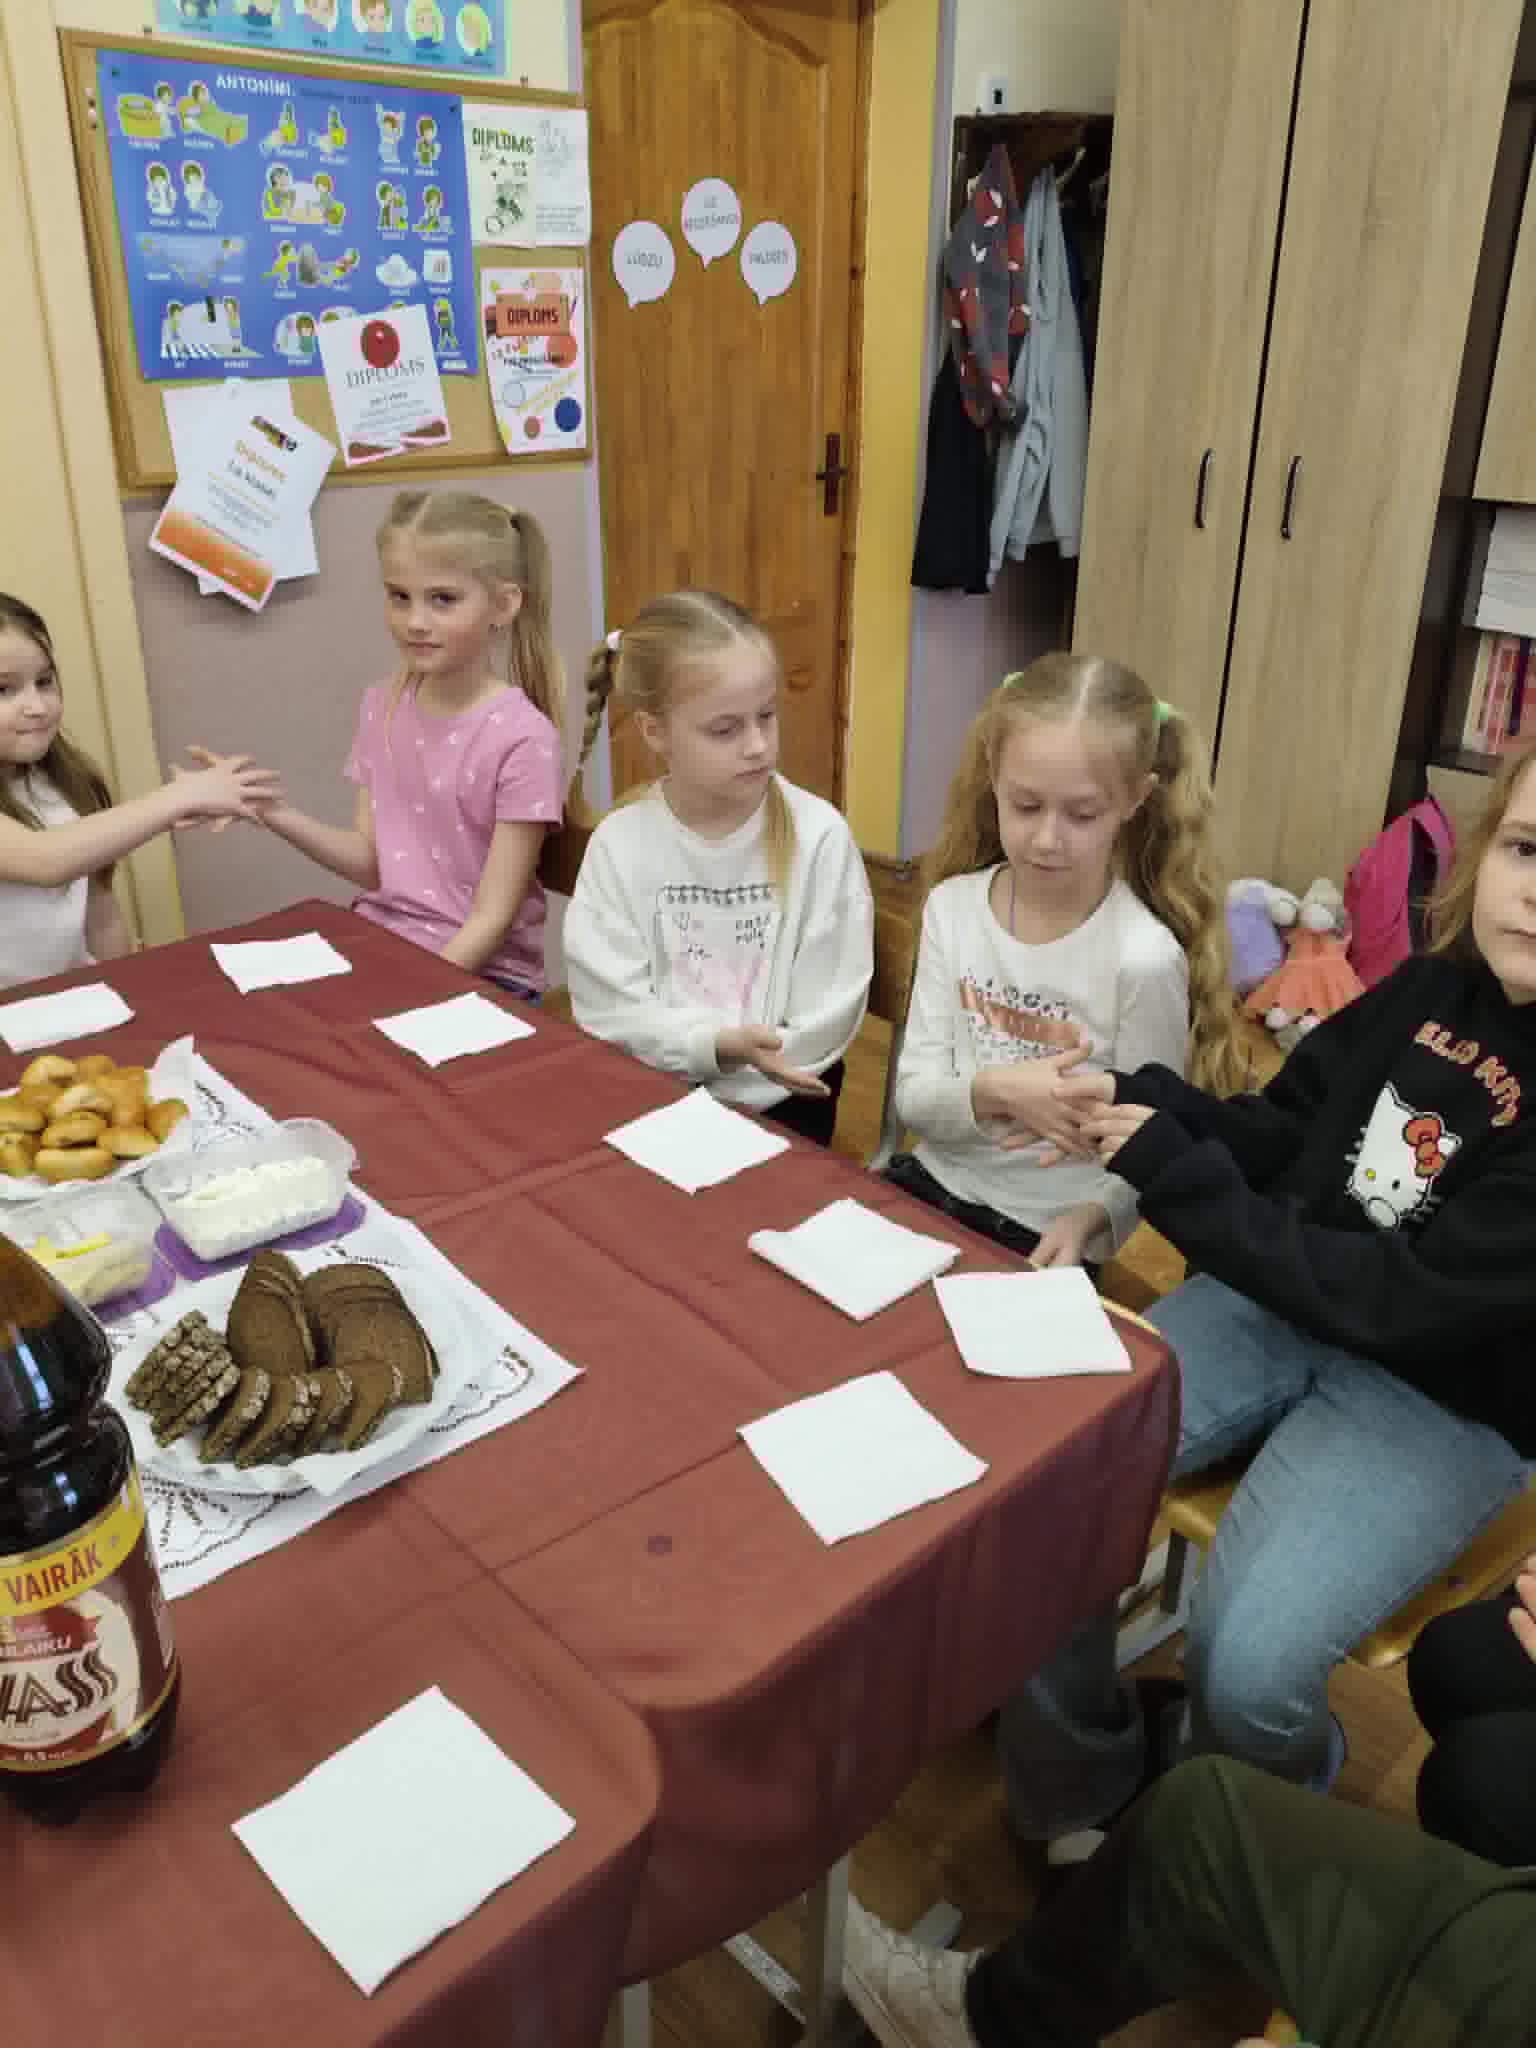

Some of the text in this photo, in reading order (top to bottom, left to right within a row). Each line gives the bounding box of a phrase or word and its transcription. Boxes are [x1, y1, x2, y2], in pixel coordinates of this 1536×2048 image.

[472, 127, 535, 155] DIPLOMS
[506, 305, 560, 327] DIPLOMS
[3, 1544, 104, 1605] VAIRĀK
